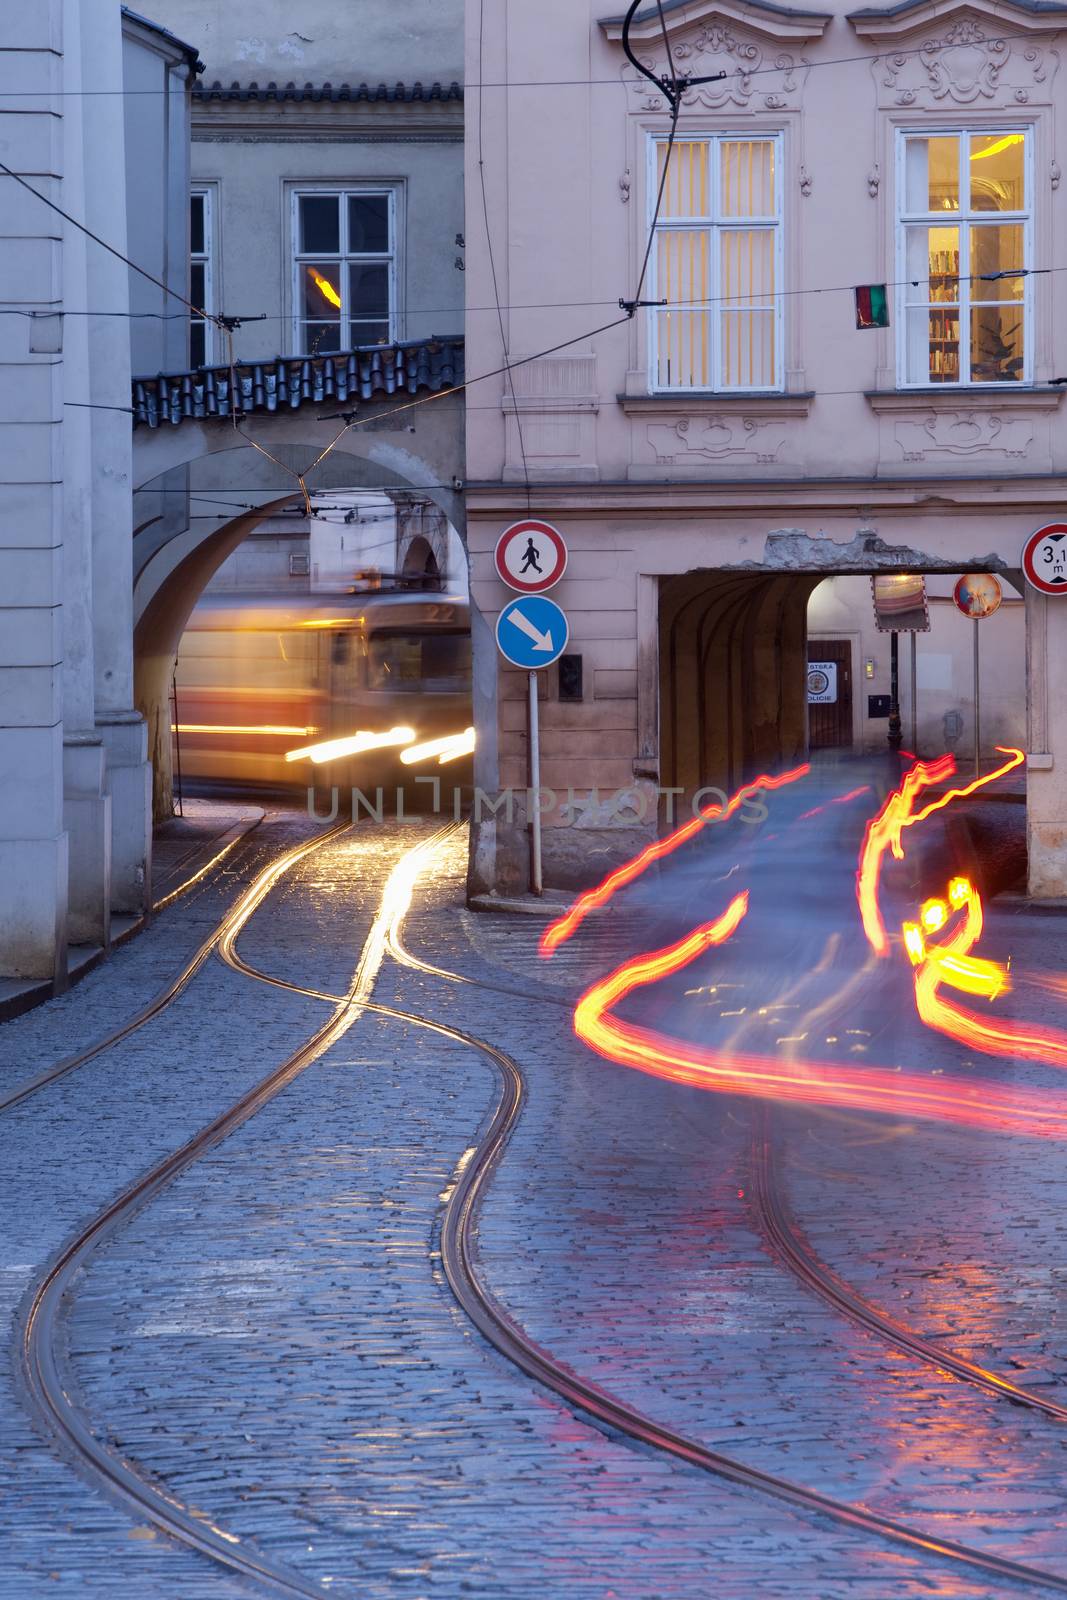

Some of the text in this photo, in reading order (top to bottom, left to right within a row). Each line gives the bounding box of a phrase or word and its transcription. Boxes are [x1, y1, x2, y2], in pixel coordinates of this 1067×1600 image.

[1043, 546, 1066, 564] 3,1
[1053, 565, 1064, 573] m
[427, 604, 455, 623] 22
